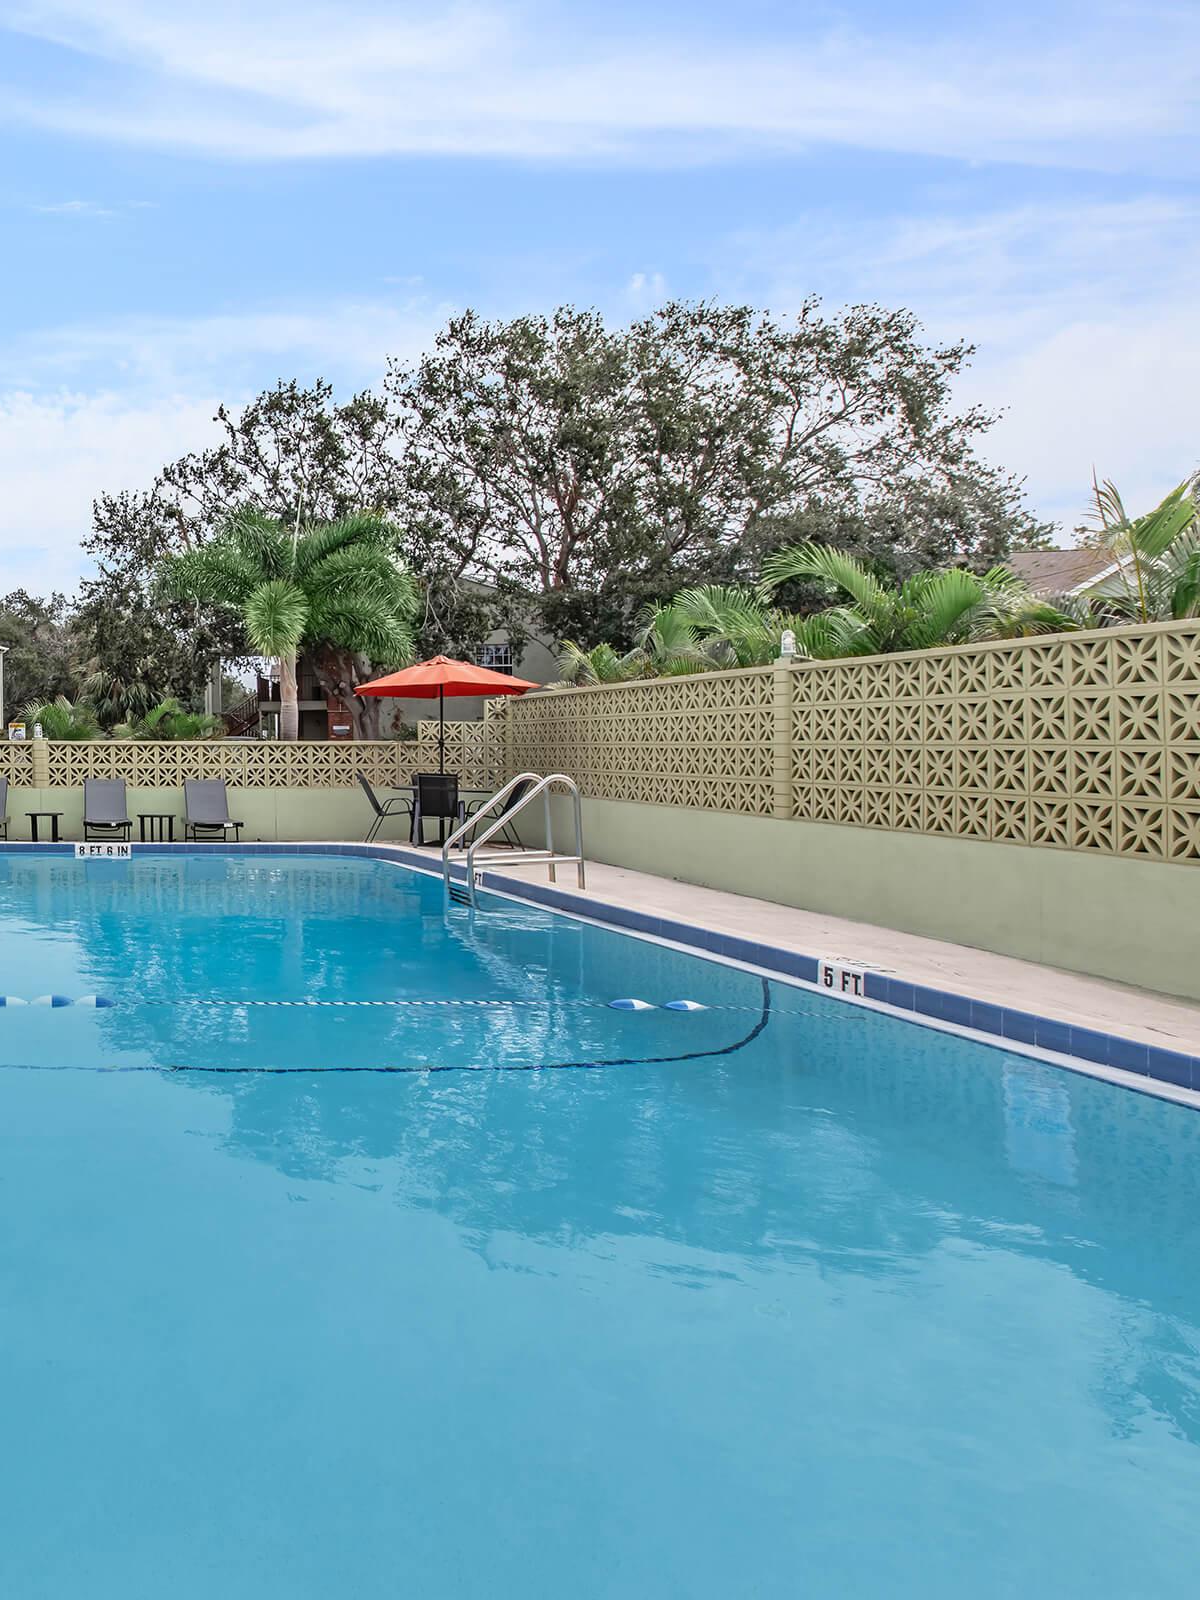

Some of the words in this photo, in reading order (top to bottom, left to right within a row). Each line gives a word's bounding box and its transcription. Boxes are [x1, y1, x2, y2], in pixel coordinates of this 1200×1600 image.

[79, 846, 85, 856] 8
[106, 846, 113, 856] 6
[117, 846, 128, 856] IN
[824, 966, 833, 988] 5
